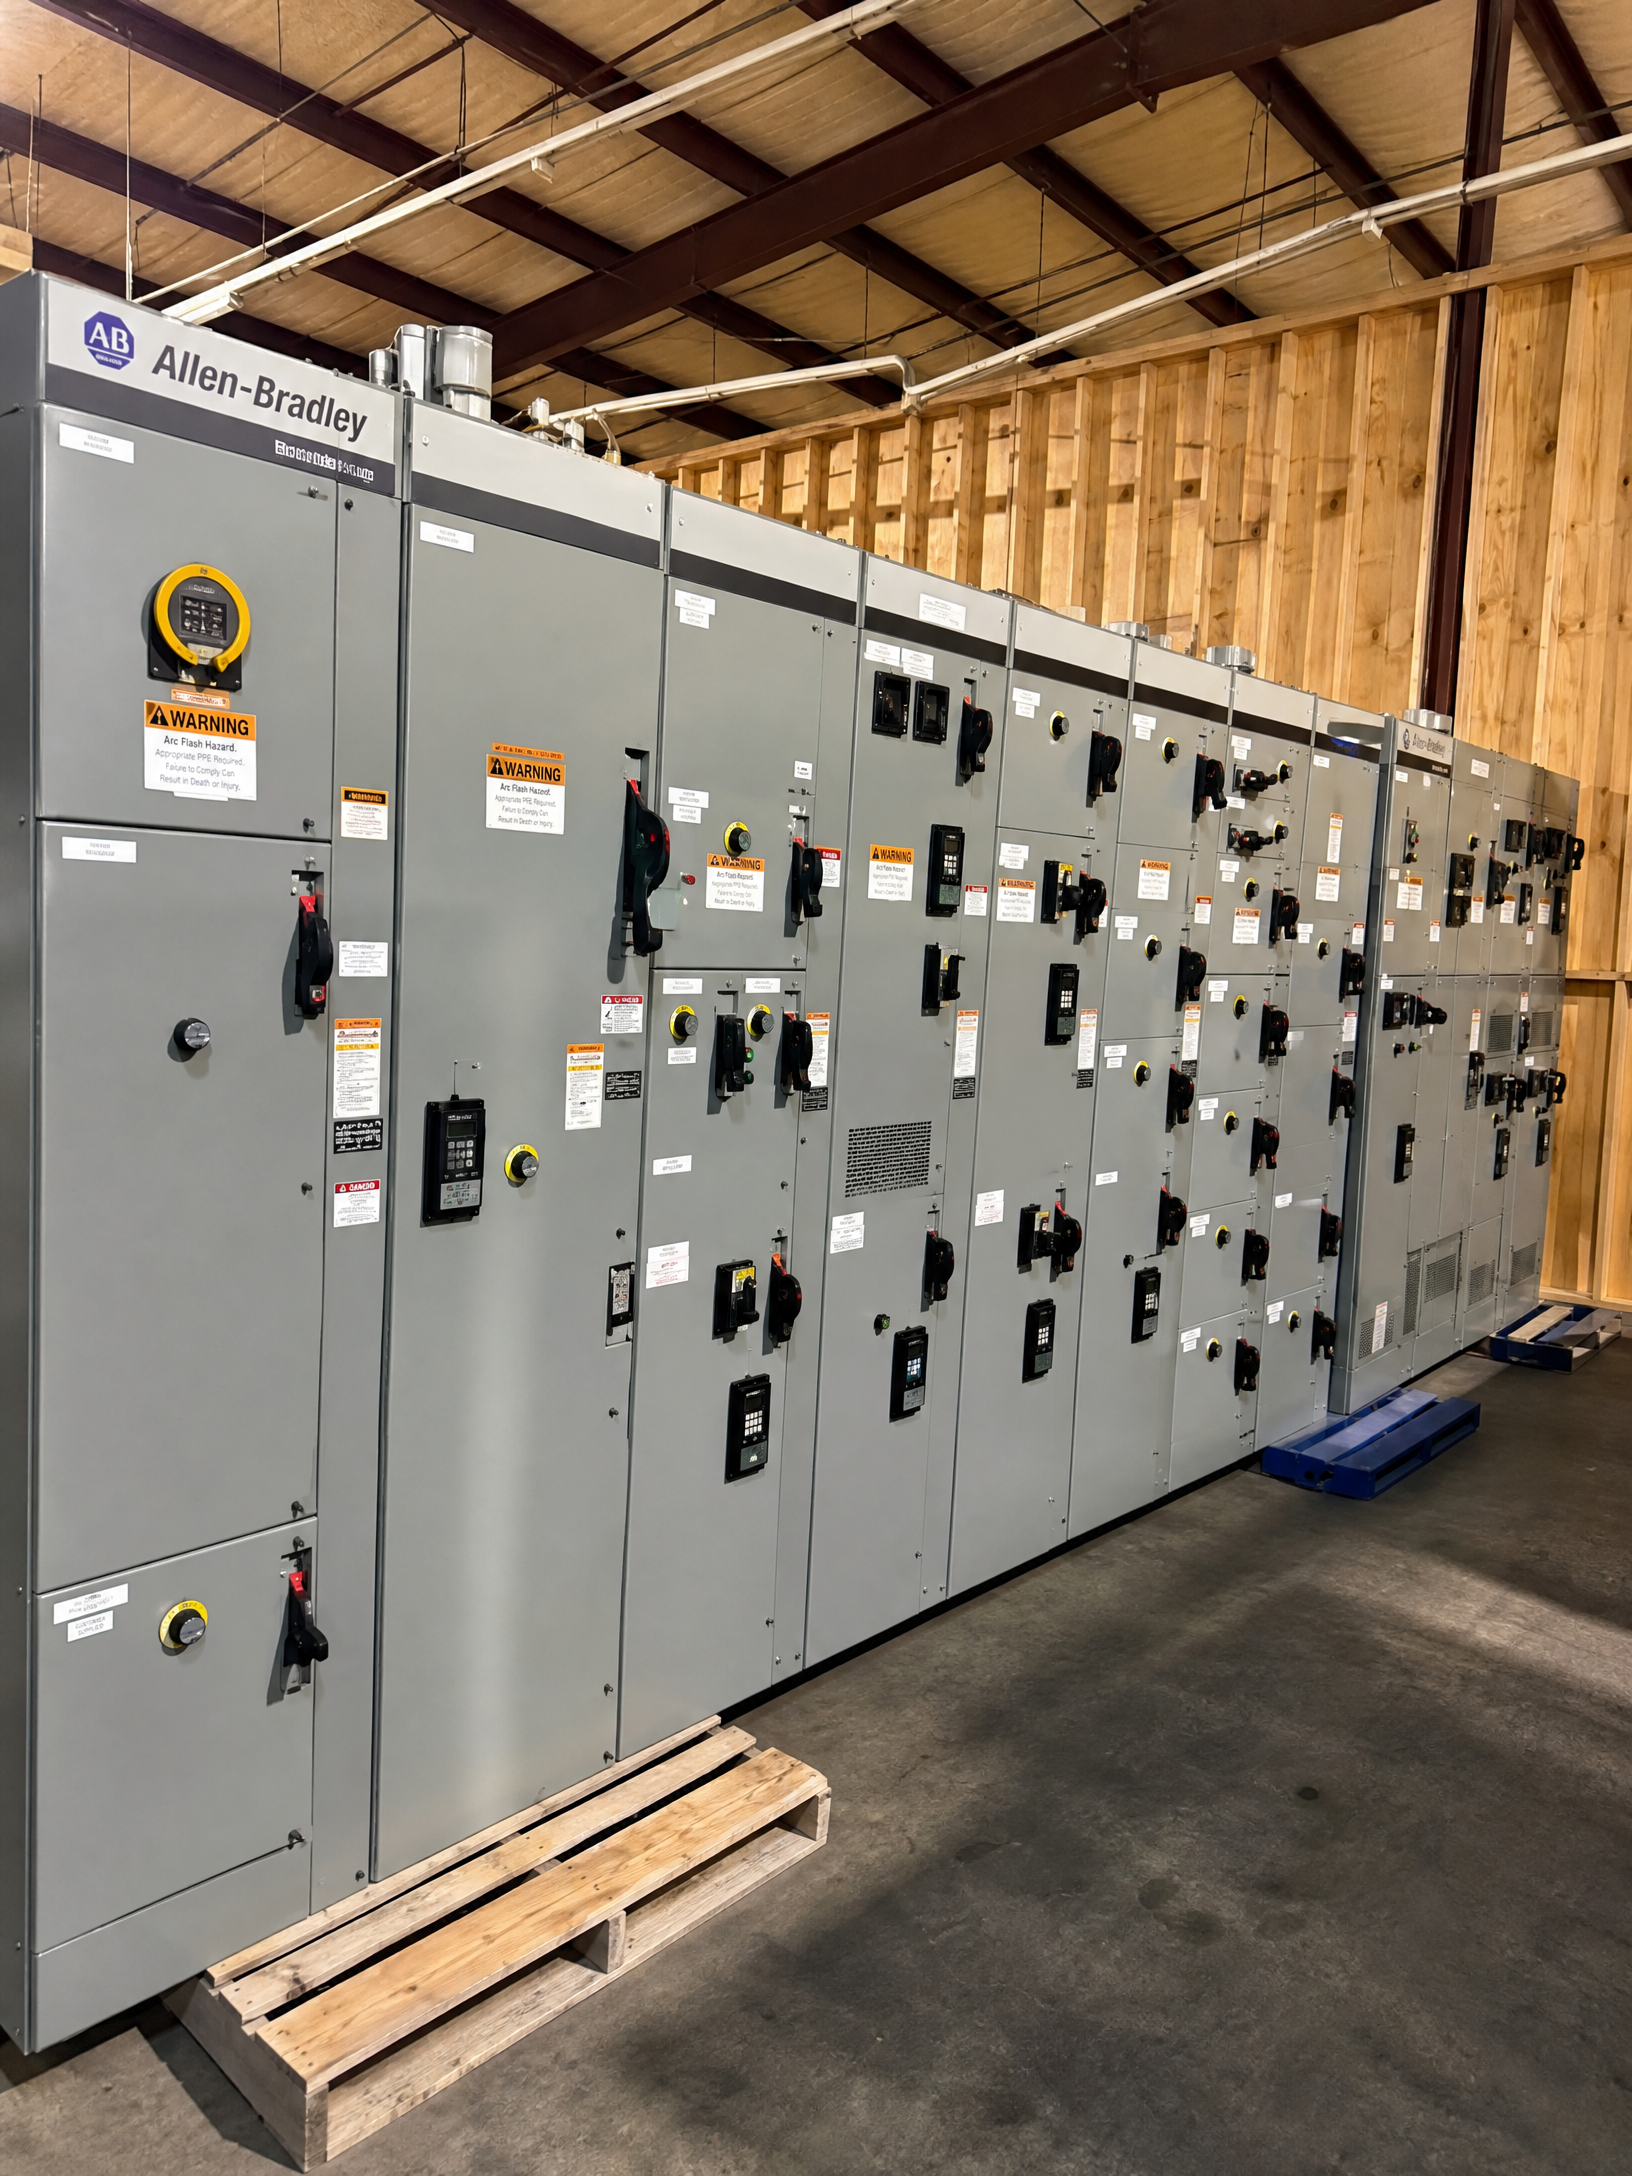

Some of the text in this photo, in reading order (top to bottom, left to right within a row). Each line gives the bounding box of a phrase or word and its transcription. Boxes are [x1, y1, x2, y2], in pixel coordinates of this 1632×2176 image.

[88, 321, 130, 355] AB
[151, 345, 368, 443] Allen-Bradley
[170, 710, 249, 736] WARNING
[164, 735, 178, 745] Arc
[205, 740, 237, 752] Hazard.
[504, 761, 561, 782] WARNING
[880, 848, 912, 863] WARNING
